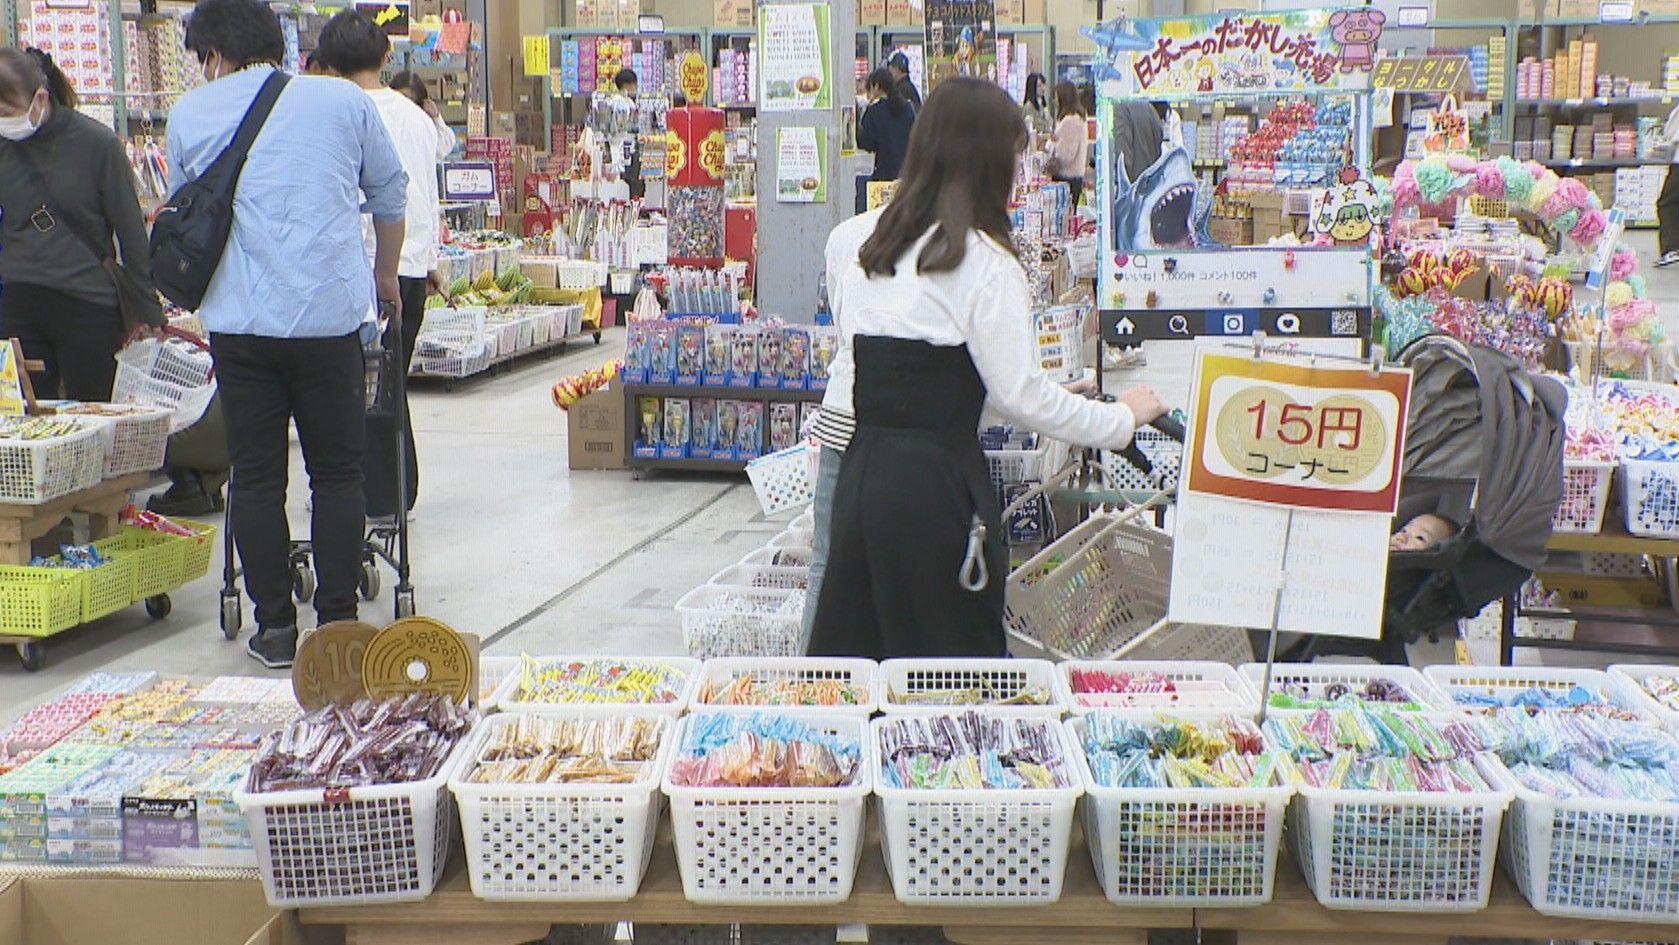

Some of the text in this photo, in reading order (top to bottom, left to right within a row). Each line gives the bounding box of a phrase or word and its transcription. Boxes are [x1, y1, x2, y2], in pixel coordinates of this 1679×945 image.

[1133, 17, 1340, 90] 日本一のだがし売場
[452, 182, 488, 192] コーナー
[1199, 271, 1257, 281] コメント100件
[1247, 400, 1362, 450] 15円
[1246, 452, 1349, 480] コーナー
[323, 639, 365, 683] 10
